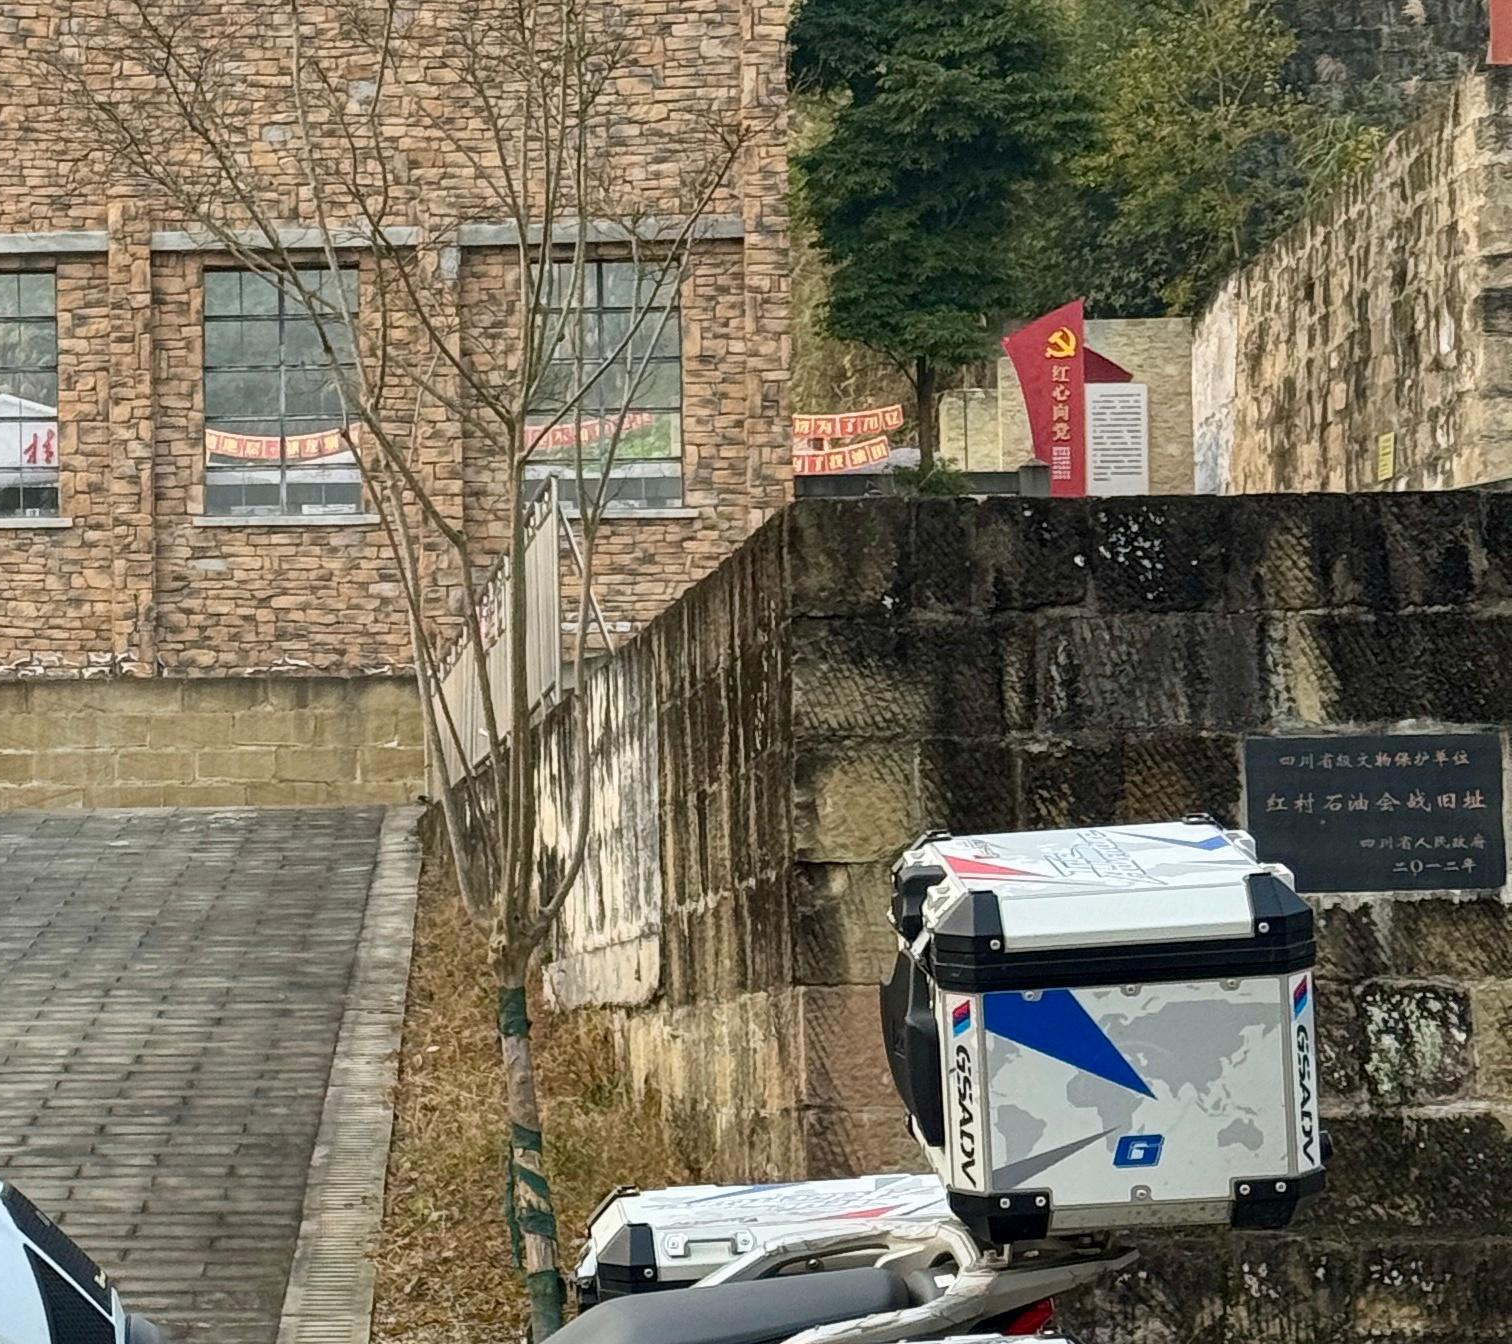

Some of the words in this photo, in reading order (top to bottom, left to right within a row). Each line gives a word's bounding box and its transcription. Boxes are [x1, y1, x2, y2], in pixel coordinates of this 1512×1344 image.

[1051, 365, 1071, 441] 红心向党
[1279, 749, 1470, 769] 四川省级文物保护单位
[1265, 789, 1487, 813] 红村石油会战旧址
[1360, 836, 1486, 850] 四川省人民政府
[955, 1044, 977, 1189] GSADV
[1297, 1023, 1316, 1165] GSADV
